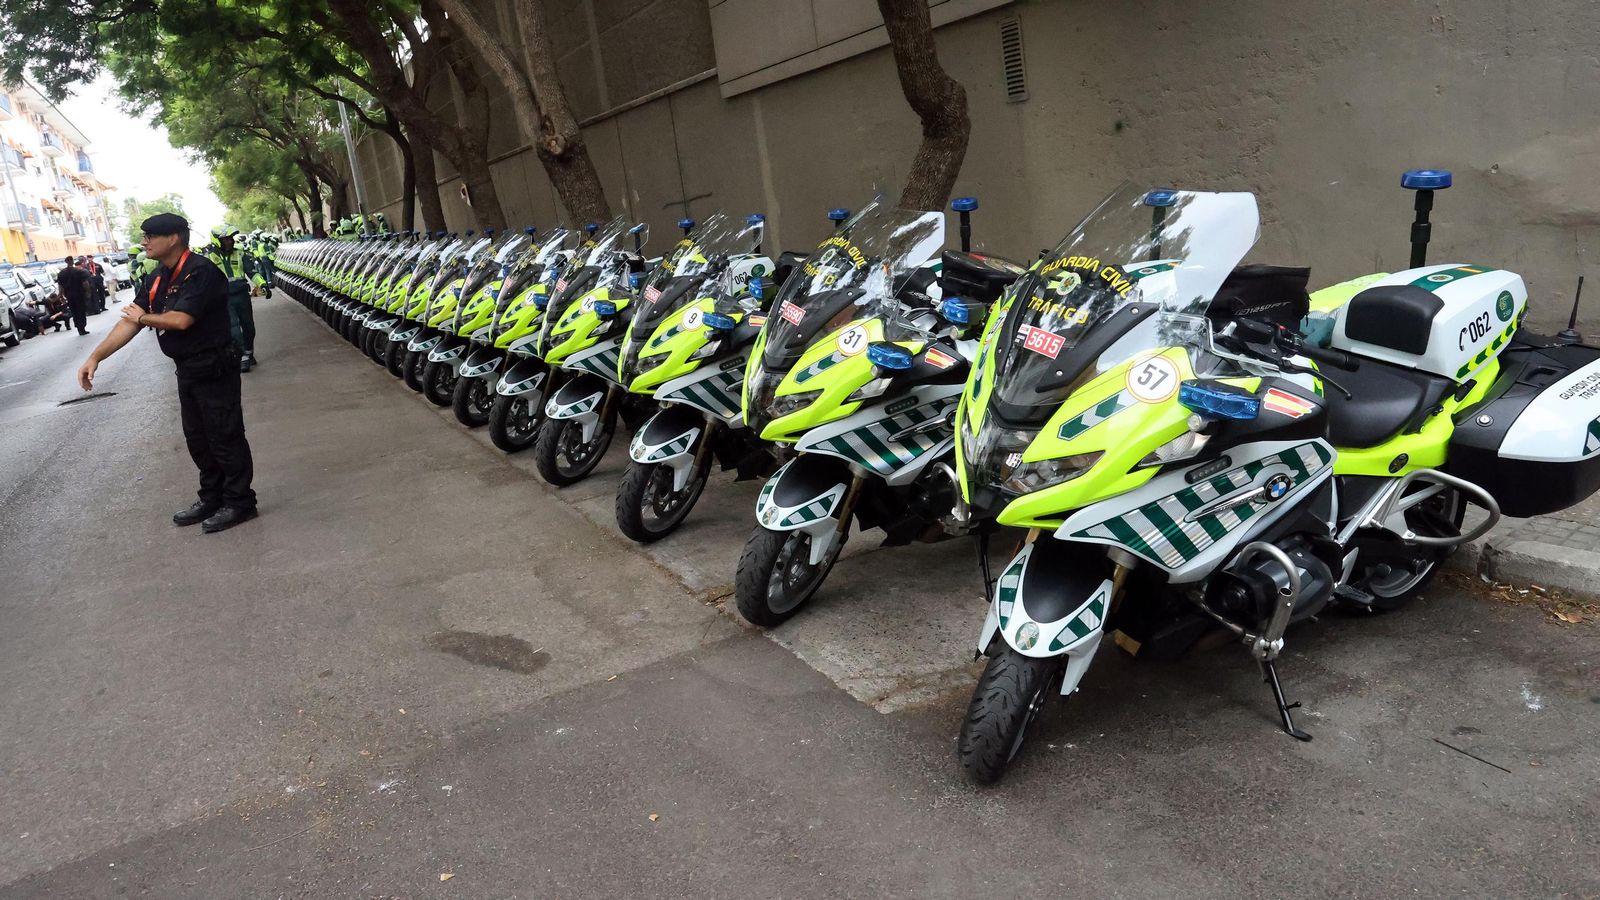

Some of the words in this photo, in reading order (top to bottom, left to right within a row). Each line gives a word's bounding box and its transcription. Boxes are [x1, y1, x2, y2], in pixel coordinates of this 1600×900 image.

[1040, 255, 1101, 275] GUARDIA
[1100, 266, 1133, 299] CIVIL
[688, 312, 698, 324] 9
[1468, 311, 1492, 343] 062
[843, 330, 862, 349] 31
[1027, 331, 1061, 354] 5615
[1137, 363, 1169, 391] 57
